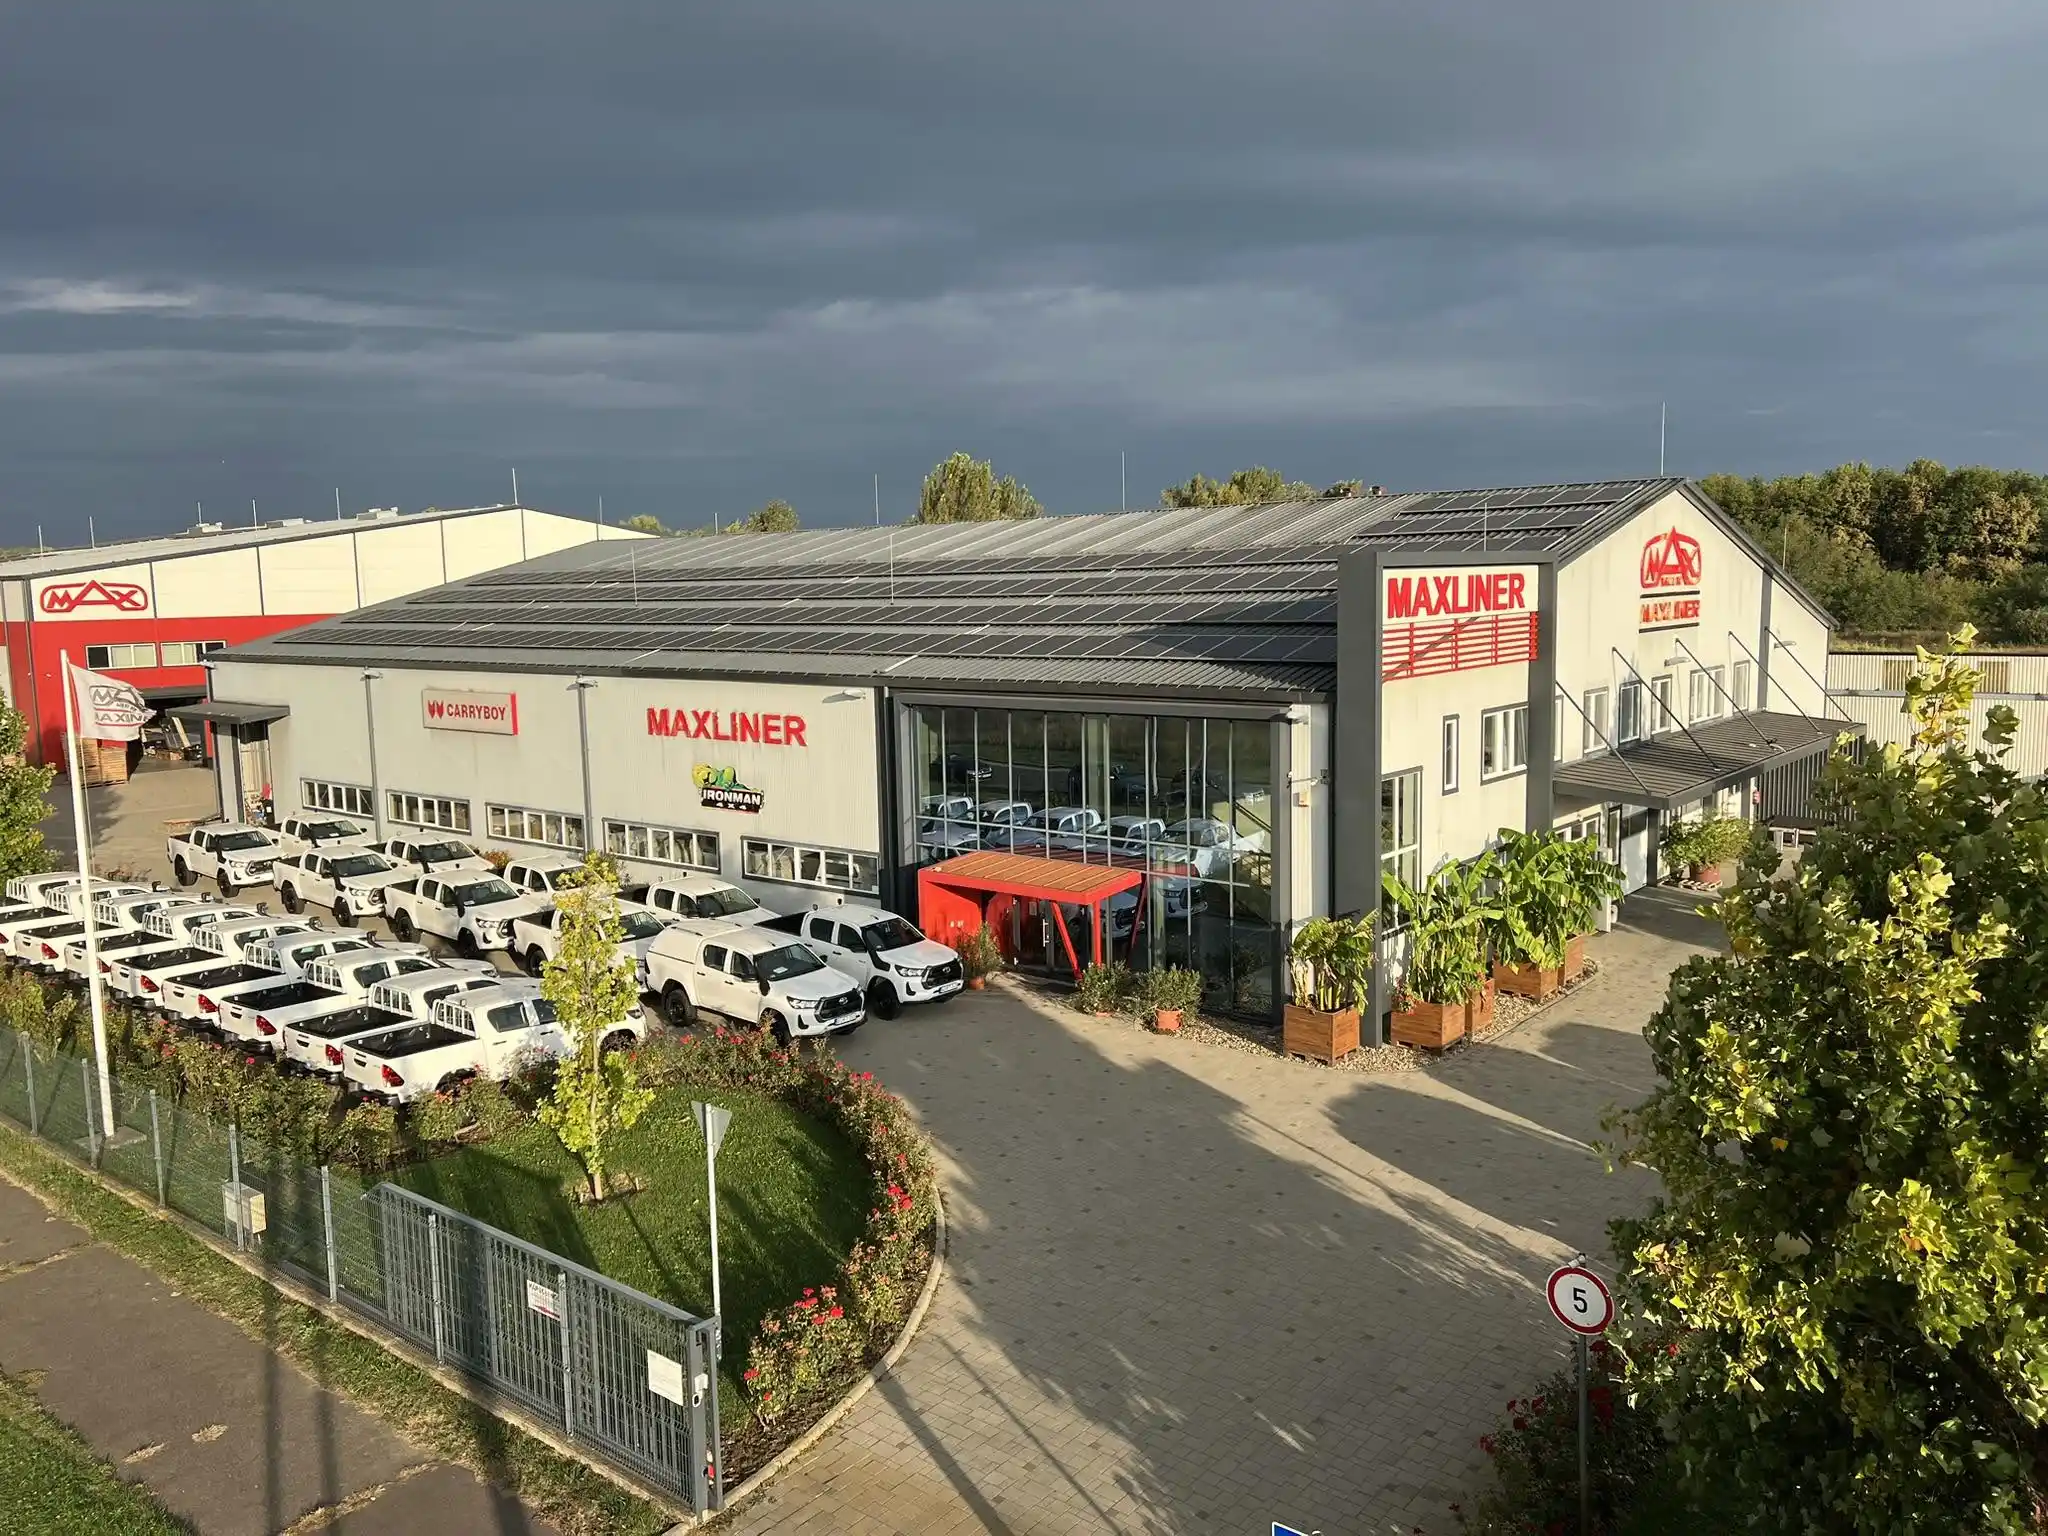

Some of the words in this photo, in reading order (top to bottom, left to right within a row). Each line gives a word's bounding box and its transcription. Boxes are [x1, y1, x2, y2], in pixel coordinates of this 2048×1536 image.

[44, 580, 145, 610] MAX
[1387, 573, 1526, 618] MAXLINER
[446, 704, 506, 720] CARRYBOY
[647, 707, 807, 747] MAXLINER
[703, 789, 761, 805] IRONMAN
[1573, 1287, 1588, 1313] 5
